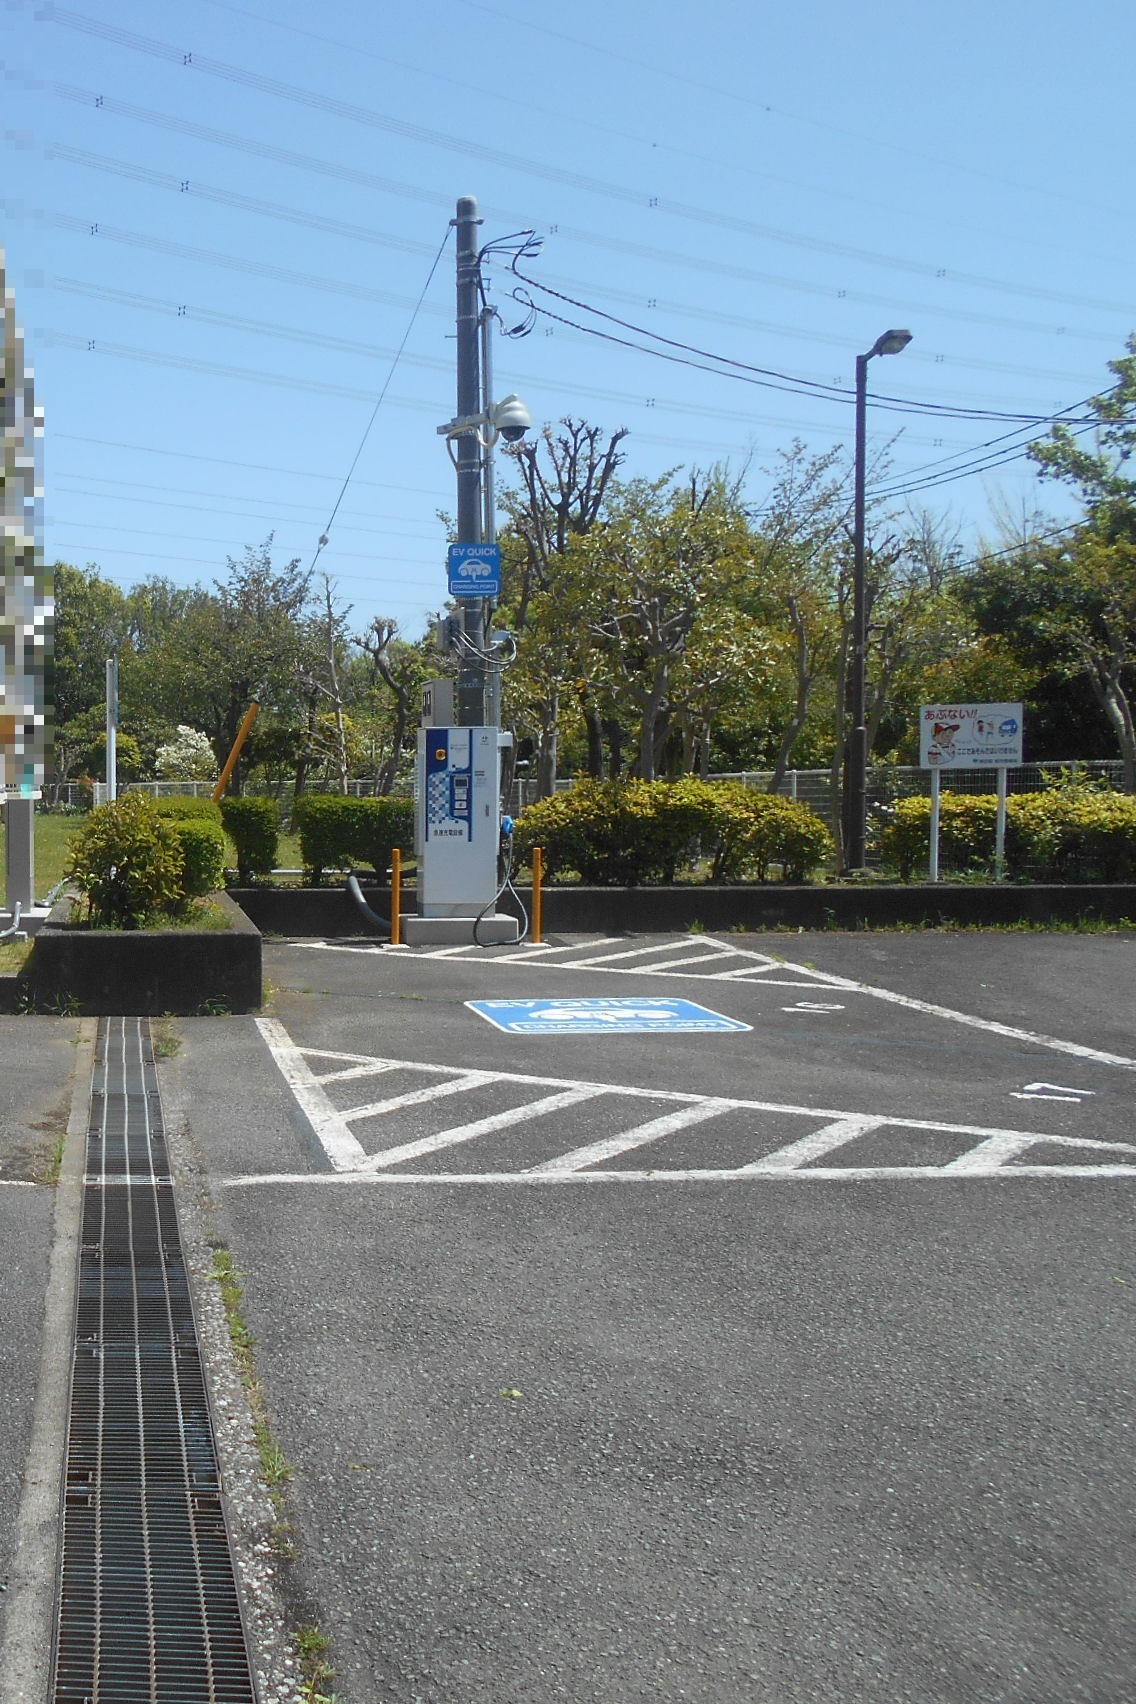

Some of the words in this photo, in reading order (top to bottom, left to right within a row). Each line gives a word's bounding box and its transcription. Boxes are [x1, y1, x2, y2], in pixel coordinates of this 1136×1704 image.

[452, 547, 465, 556] EV
[467, 547, 497, 556] QUICK
[485, 1000, 536, 1009] EV
[549, 1000, 679, 1008] QUICK
